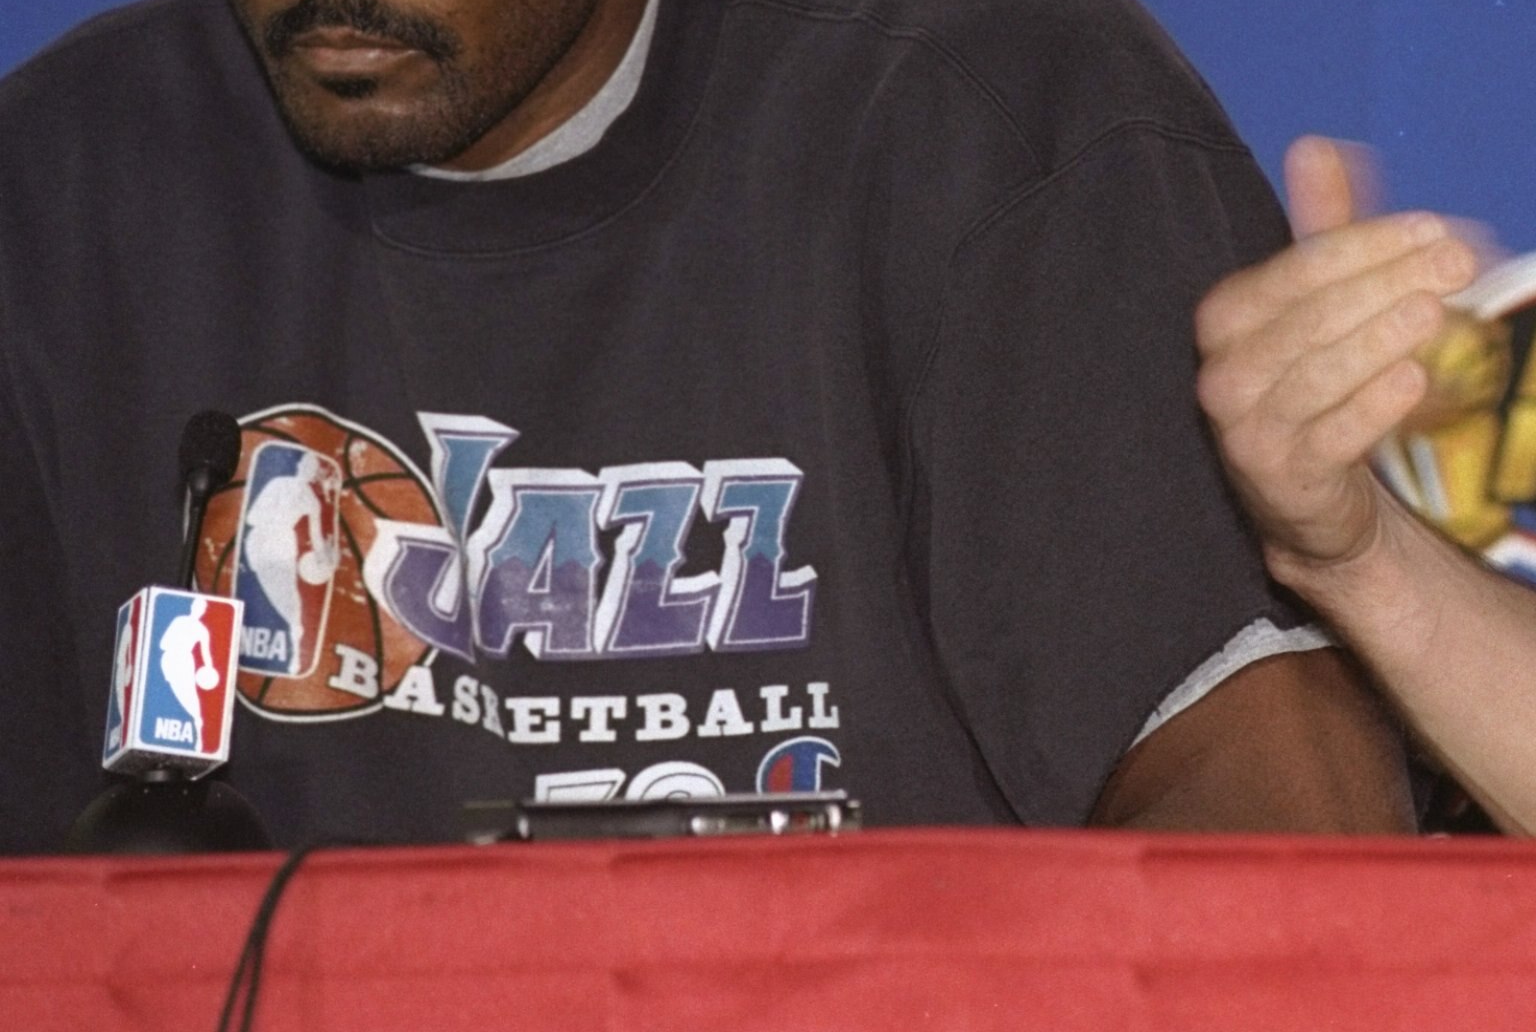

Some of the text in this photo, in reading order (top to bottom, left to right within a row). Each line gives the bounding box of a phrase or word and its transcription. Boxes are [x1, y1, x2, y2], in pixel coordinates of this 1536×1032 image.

[240, 625, 288, 662] NBA
[329, 643, 839, 744] BASKETBALL
[154, 717, 195, 743] NBA
